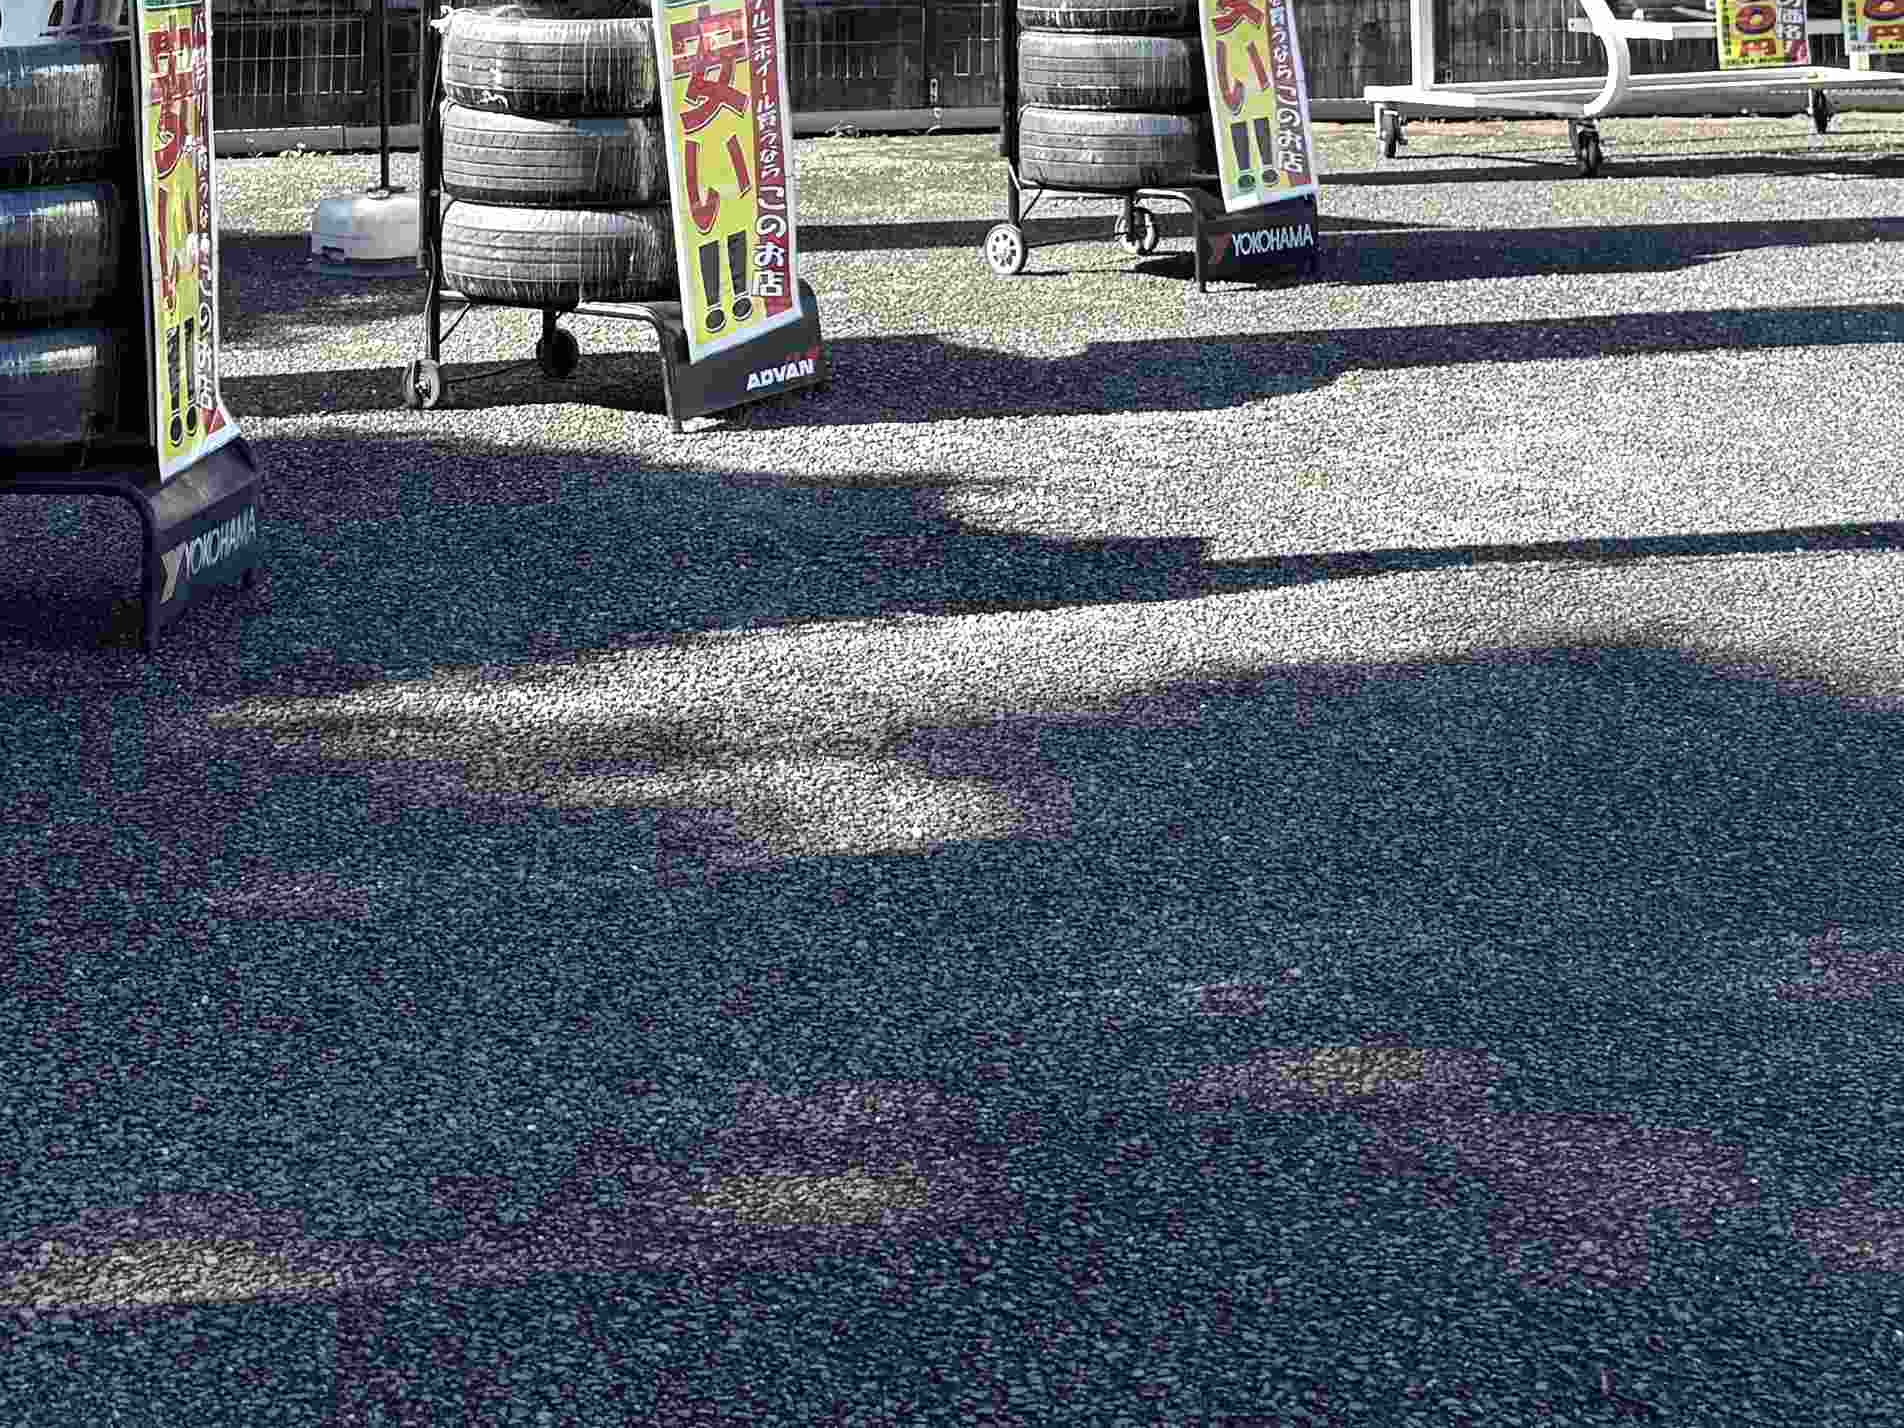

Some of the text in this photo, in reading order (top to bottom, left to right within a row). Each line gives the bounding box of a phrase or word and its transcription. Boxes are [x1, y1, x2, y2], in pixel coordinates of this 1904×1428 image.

[1231, 223, 1313, 257] YOKOHAMA
[745, 357, 817, 391] ADVAN
[183, 505, 257, 581] YOKOHAMA
